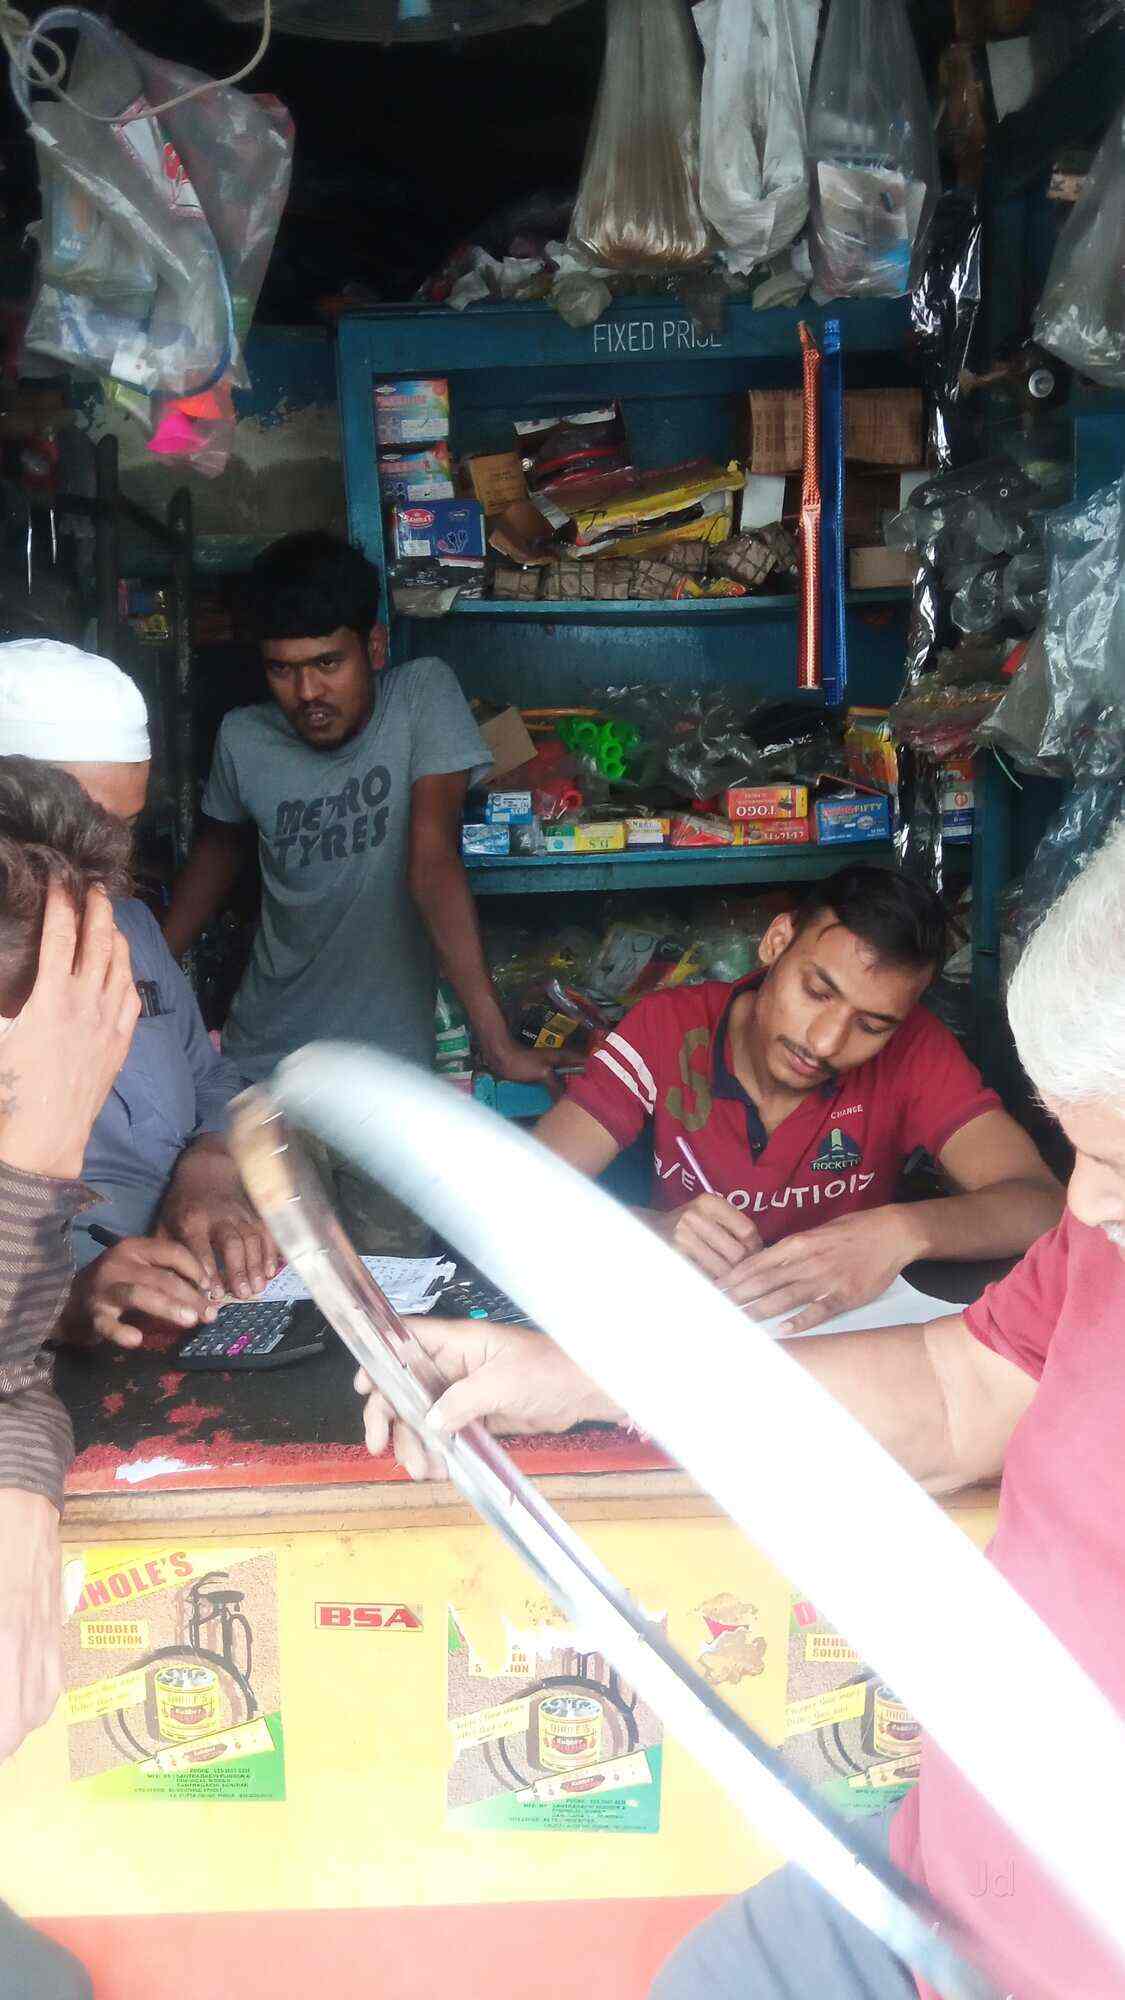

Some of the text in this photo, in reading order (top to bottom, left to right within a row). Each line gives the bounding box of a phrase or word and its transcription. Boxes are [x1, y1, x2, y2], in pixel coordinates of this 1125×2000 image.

[593, 321, 655, 353] FIXED
[273, 764, 392, 836] METRO
[830, 1104, 864, 1120] CHANGE
[319, 1606, 422, 1628] BSA
[87, 1623, 139, 1634] RUBBER
[87, 1635, 143, 1646] SOLUTION
